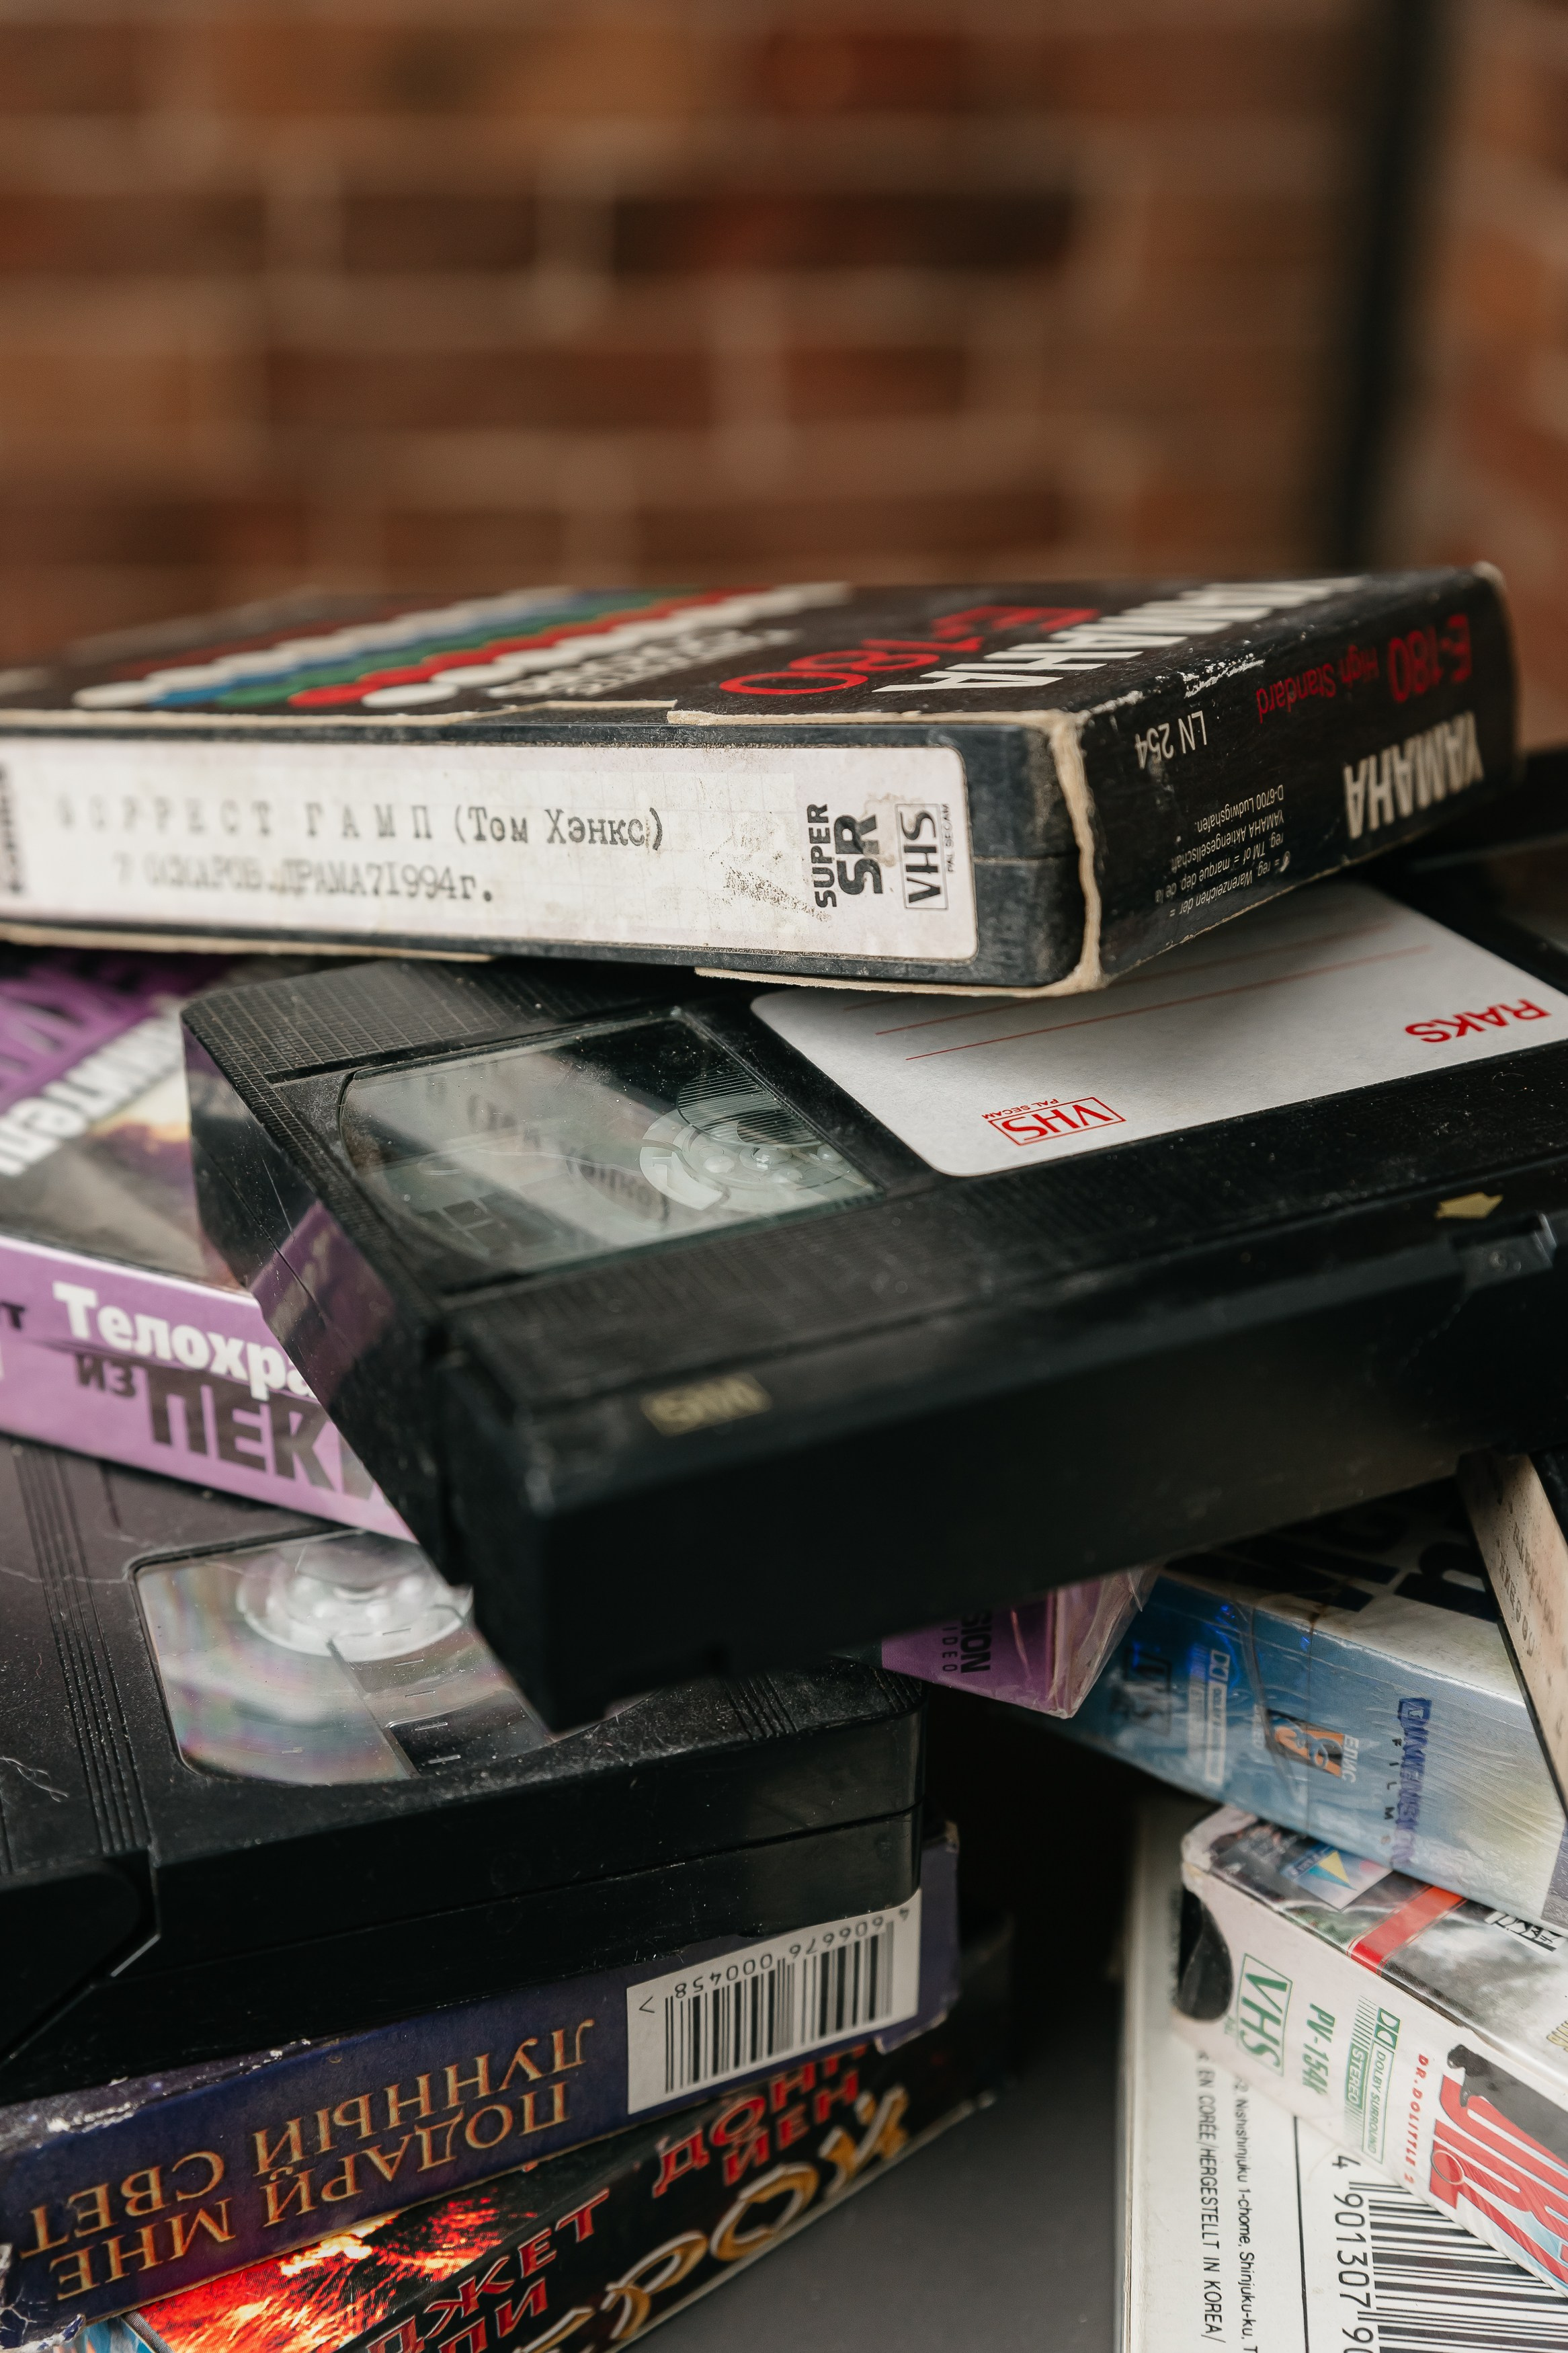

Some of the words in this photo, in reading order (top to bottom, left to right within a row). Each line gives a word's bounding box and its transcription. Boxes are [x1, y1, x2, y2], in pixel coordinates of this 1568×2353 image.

[1338, 642, 1379, 686] High
[1255, 662, 1336, 724] Standard
[1134, 723, 1175, 770] 254
[1178, 711, 1207, 754] LN
[1255, 785, 1284, 812] D-6700
[1342, 710, 1485, 840] YAMAHA
[304, 802, 434, 839] ГАМП
[454, 805, 528, 844] (Том
[545, 807, 663, 850] Хэнкс)
[1248, 809, 1284, 838] YAMAHA
[807, 803, 837, 908] SUPER
[833, 814, 883, 895] SR
[899, 809, 941, 904] VHS
[1199, 857, 1230, 881] marque
[1243, 847, 1251, 865] of
[1253, 841, 1266, 860] TM
[1166, 882, 1177, 899] de
[1179, 896, 1194, 915] der
[1195, 870, 1253, 906] Warenzeichen
[1404, 999, 1551, 1043] RAKS
[981, 1105, 1030, 1119] SECAM
[1001, 1104, 1114, 1142] VHS
[1030, 1098, 1059, 1107] PAL
[942, 1626, 959, 1671] IDEO
[960, 1609, 992, 1673] SION
[788, 1914, 885, 1960] 606676
[673, 1952, 774, 1999] 000458
[1239, 1971, 1288, 2071] VHS
[1347, 2048, 1365, 2106] STEREO
[1371, 2050, 1387, 2092] DOLBY
[251, 2019, 595, 2182] ЛУННЫЙ
[652, 2044, 868, 2199] ДОН
[1367, 2091, 1381, 2155] SURROUND
[265, 2081, 570, 2228] ПОДАРИ
[1235, 2098, 1250, 2182] Nishishinjuku
[1332, 2155, 1362, 2169] 4
[20, 2151, 226, 2260] СВЕТ
[1237, 2188, 1253, 2247] 1-chome,
[48, 2196, 237, 2302] МНЕ
[366, 2188, 610, 2353] ДЖЕТ
[1203, 2257, 1220, 2272] IN
[1333, 2192, 1372, 2309] 901307
[1238, 2251, 1257, 2340] Shinjuku-ku,
